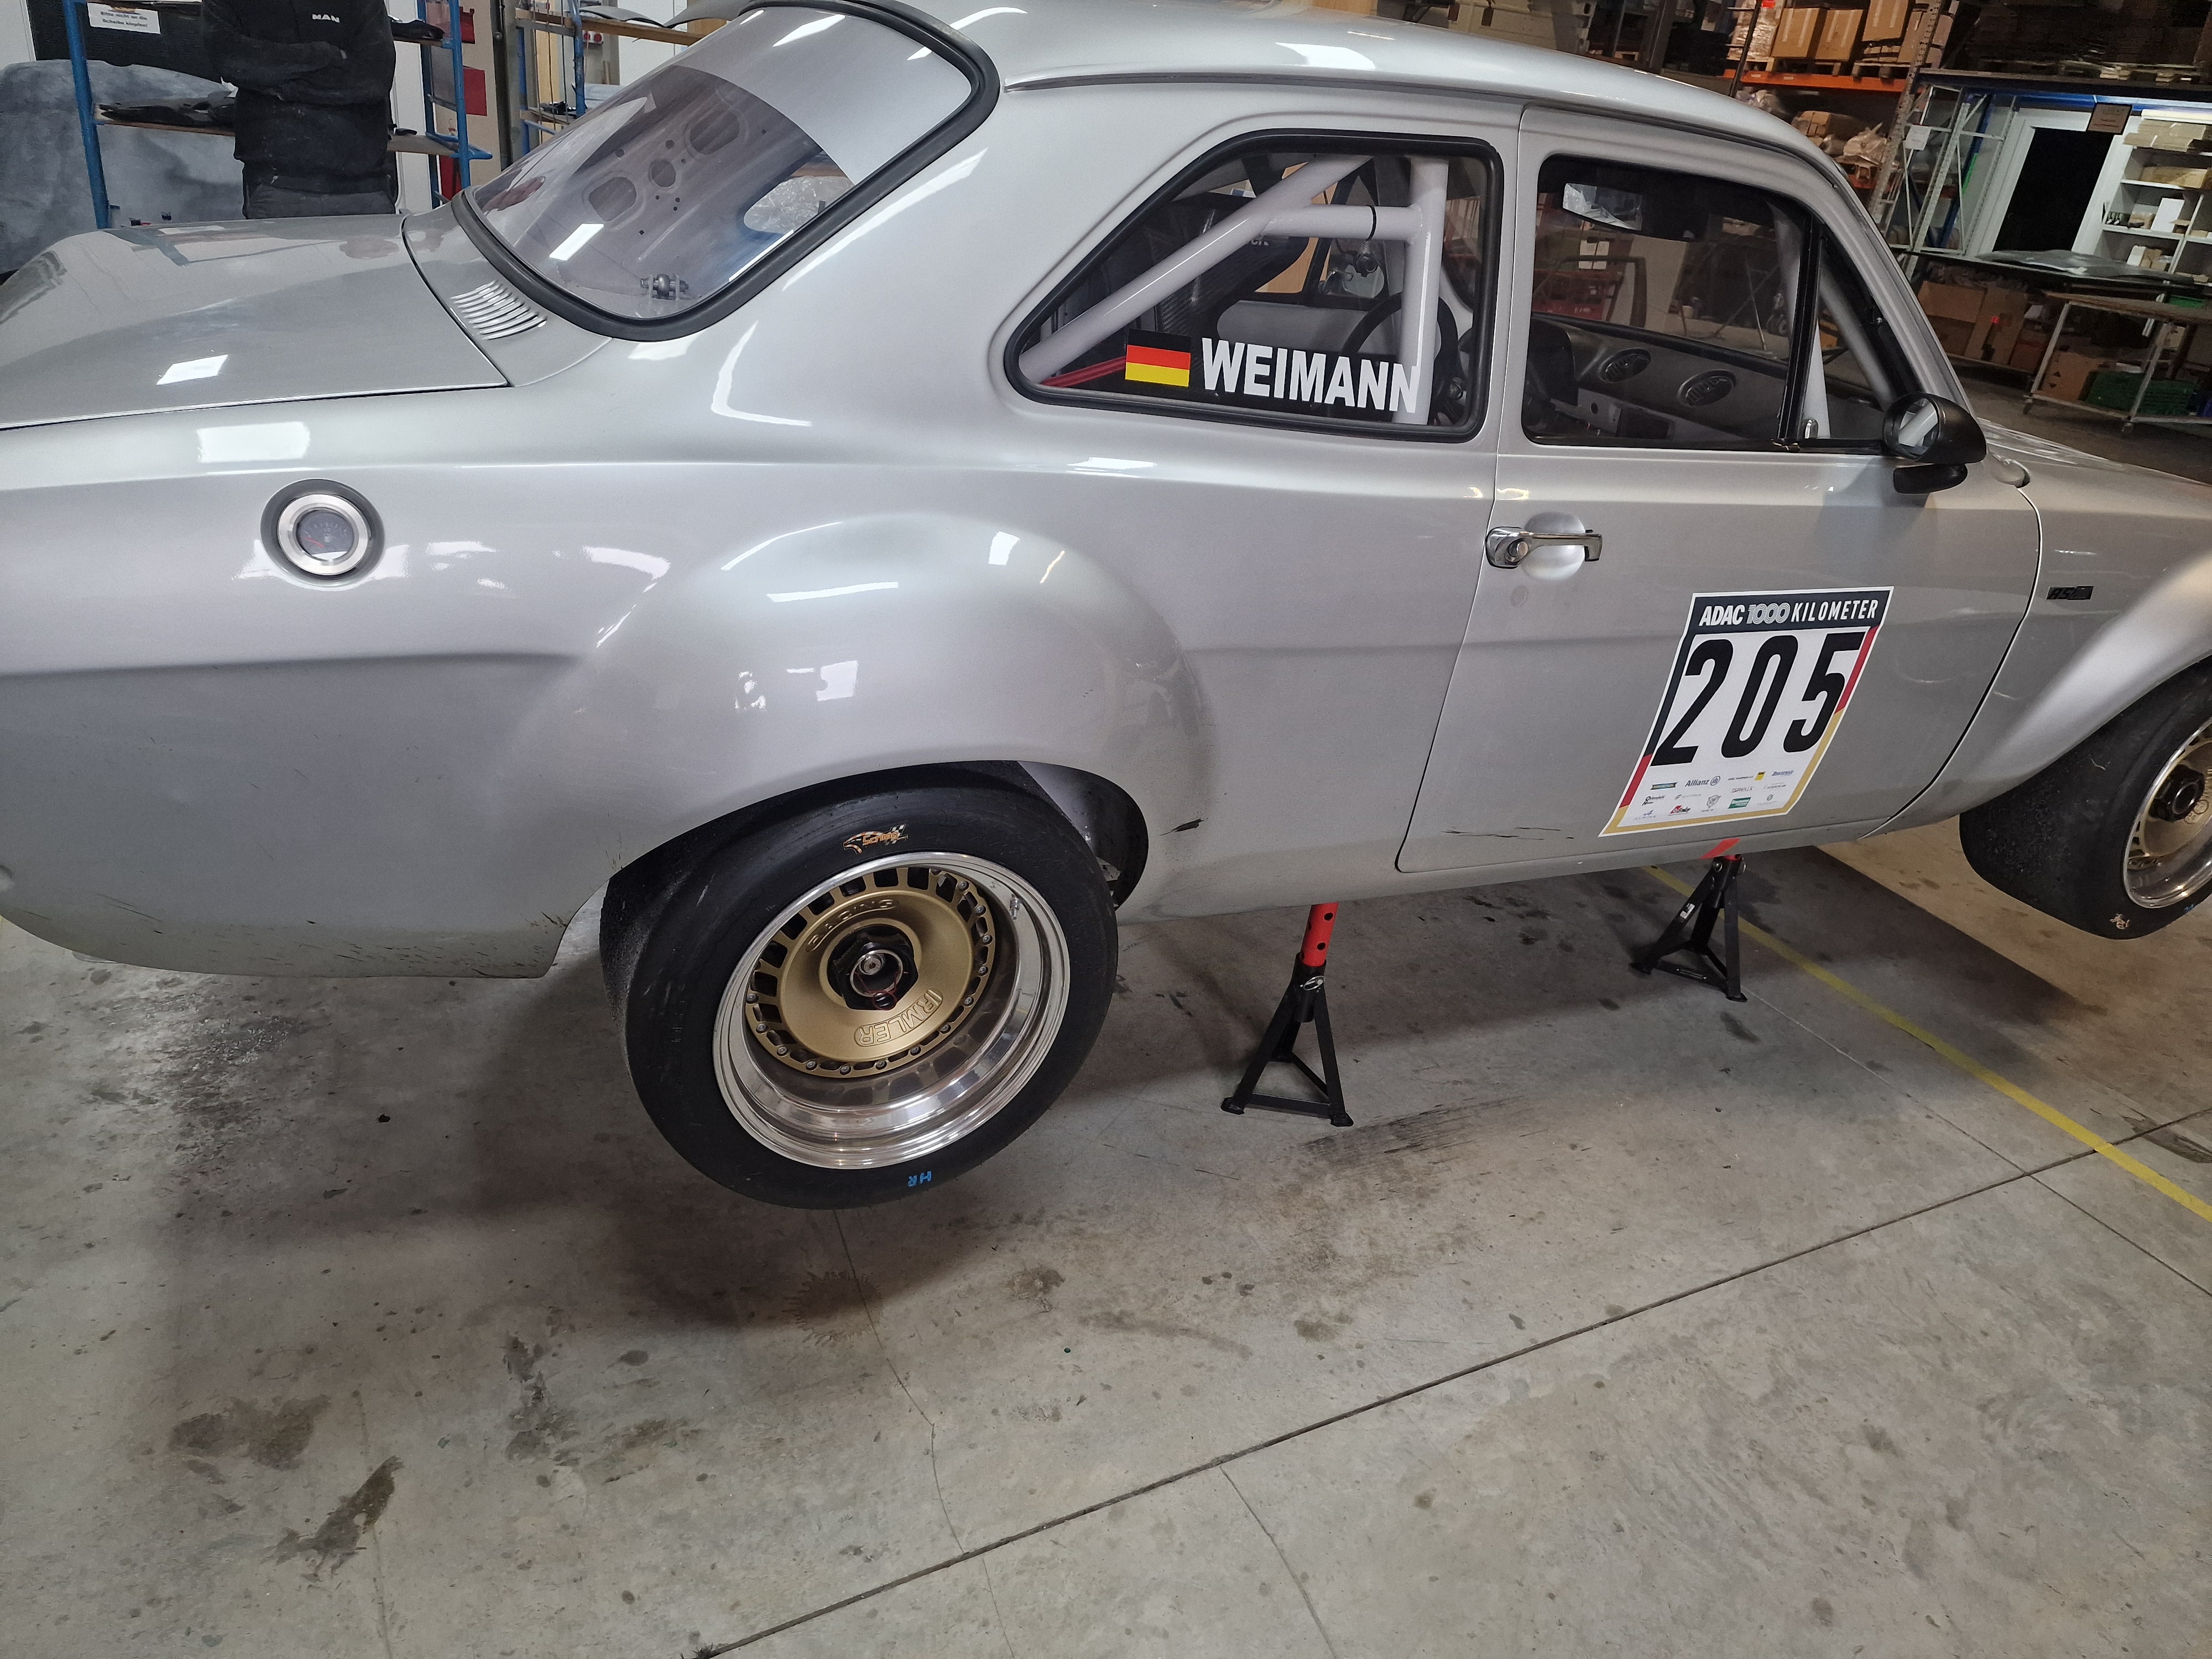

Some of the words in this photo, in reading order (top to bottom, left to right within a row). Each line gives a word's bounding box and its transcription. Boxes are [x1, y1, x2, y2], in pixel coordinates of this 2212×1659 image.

[312, 13, 340, 23] MAN
[1202, 337, 1420, 413] WEIMANN
[1699, 604, 1745, 627] ADAC
[1746, 602, 1790, 625] 1000
[1790, 599, 1879, 623] KILOMETER
[1650, 632, 1866, 766] 205
[1684, 779, 1710, 787] Allianz
[857, 988, 943, 1045] IRMLER
[907, 1171, 932, 1187] HR
